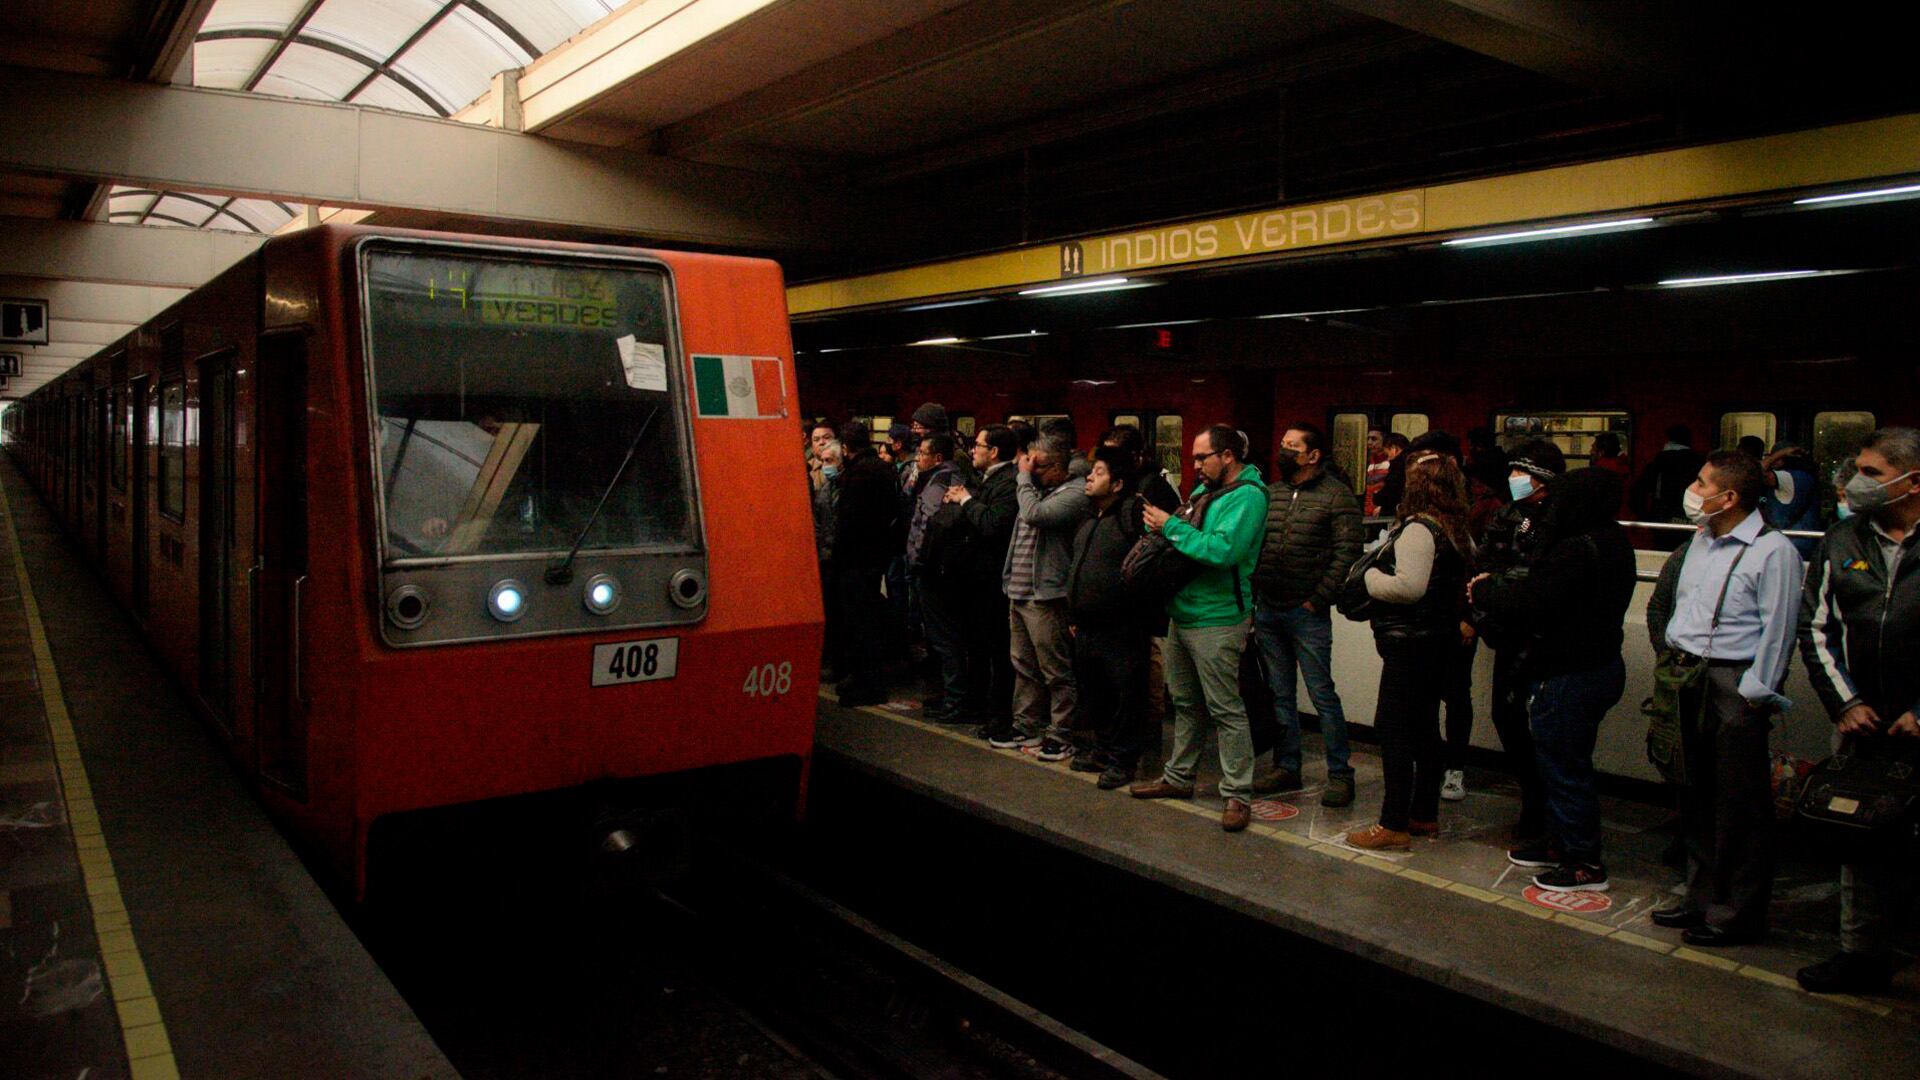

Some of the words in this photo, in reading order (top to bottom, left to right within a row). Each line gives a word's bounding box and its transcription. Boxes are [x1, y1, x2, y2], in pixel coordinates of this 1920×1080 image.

[1101, 224, 1218, 270] INDIOS
[1234, 194, 1420, 250] VERDES
[493, 300, 618, 328] VERDES
[608, 643, 658, 679] 408
[741, 660, 793, 697] 408
